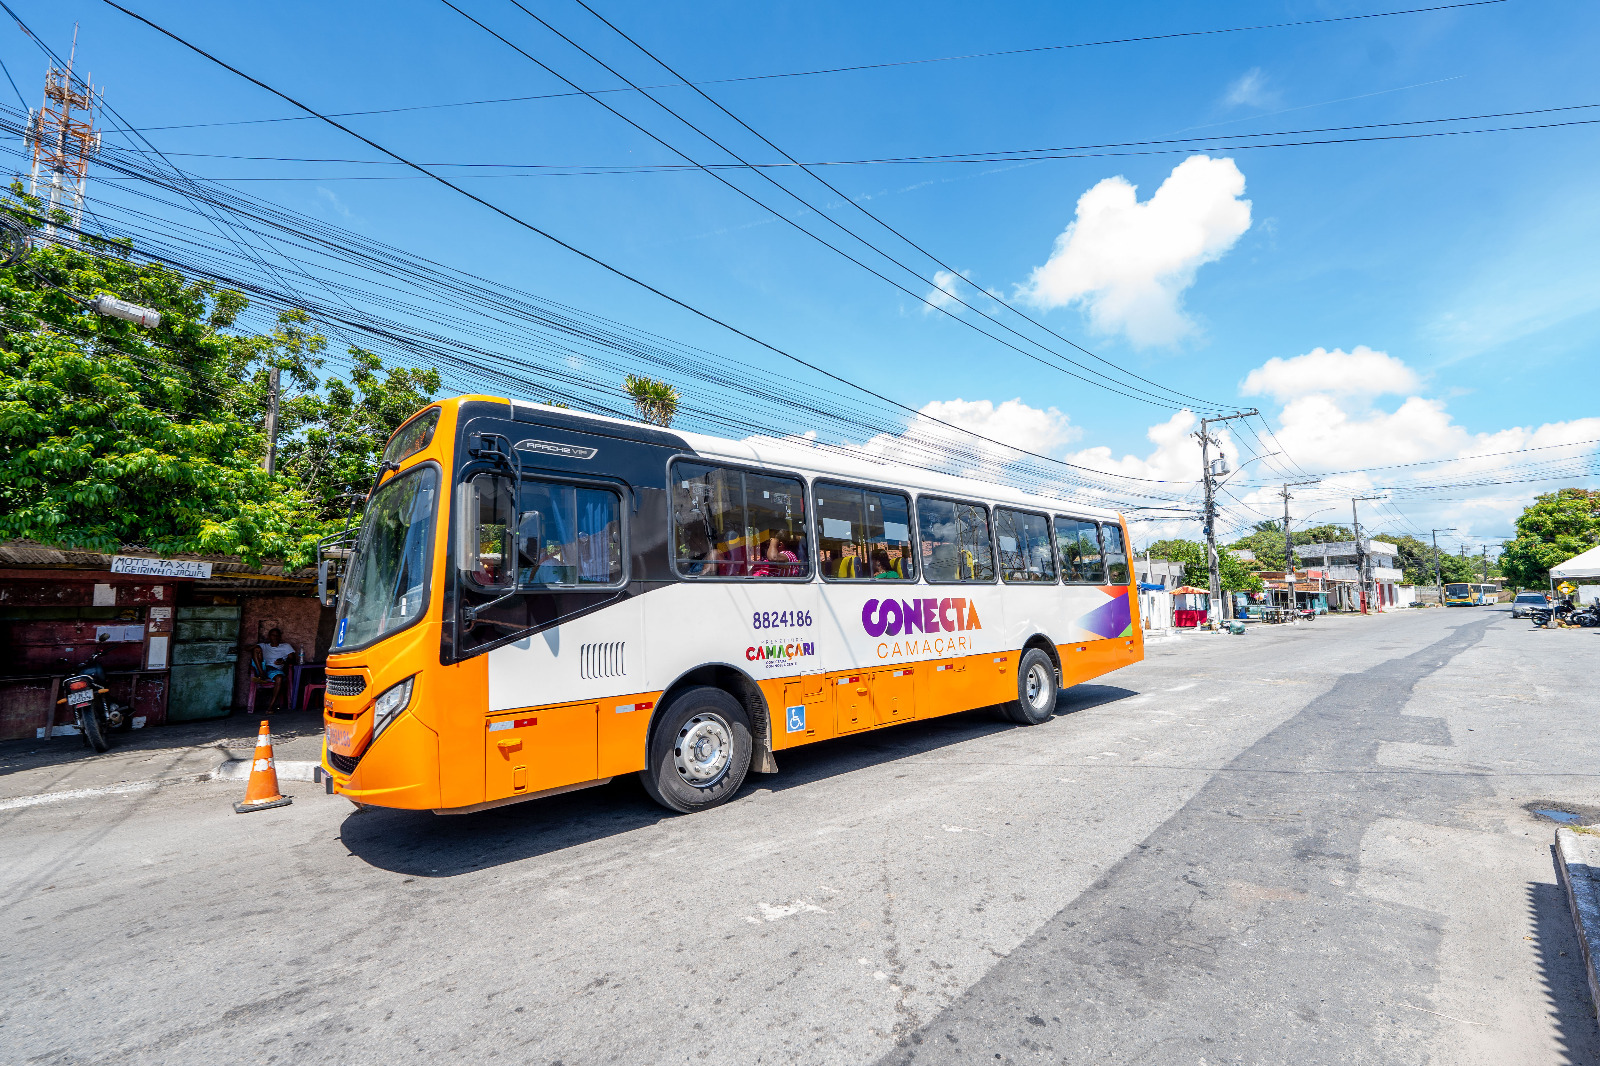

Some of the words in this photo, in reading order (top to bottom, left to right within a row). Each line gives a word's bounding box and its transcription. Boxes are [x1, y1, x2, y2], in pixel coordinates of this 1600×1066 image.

[526, 442, 571, 454] APACHE
[753, 609, 812, 630] 8824186
[861, 597, 982, 638] CONECTA
[745, 641, 815, 662] CAMAÇARI
[876, 636, 972, 659] CAMAÇARI
